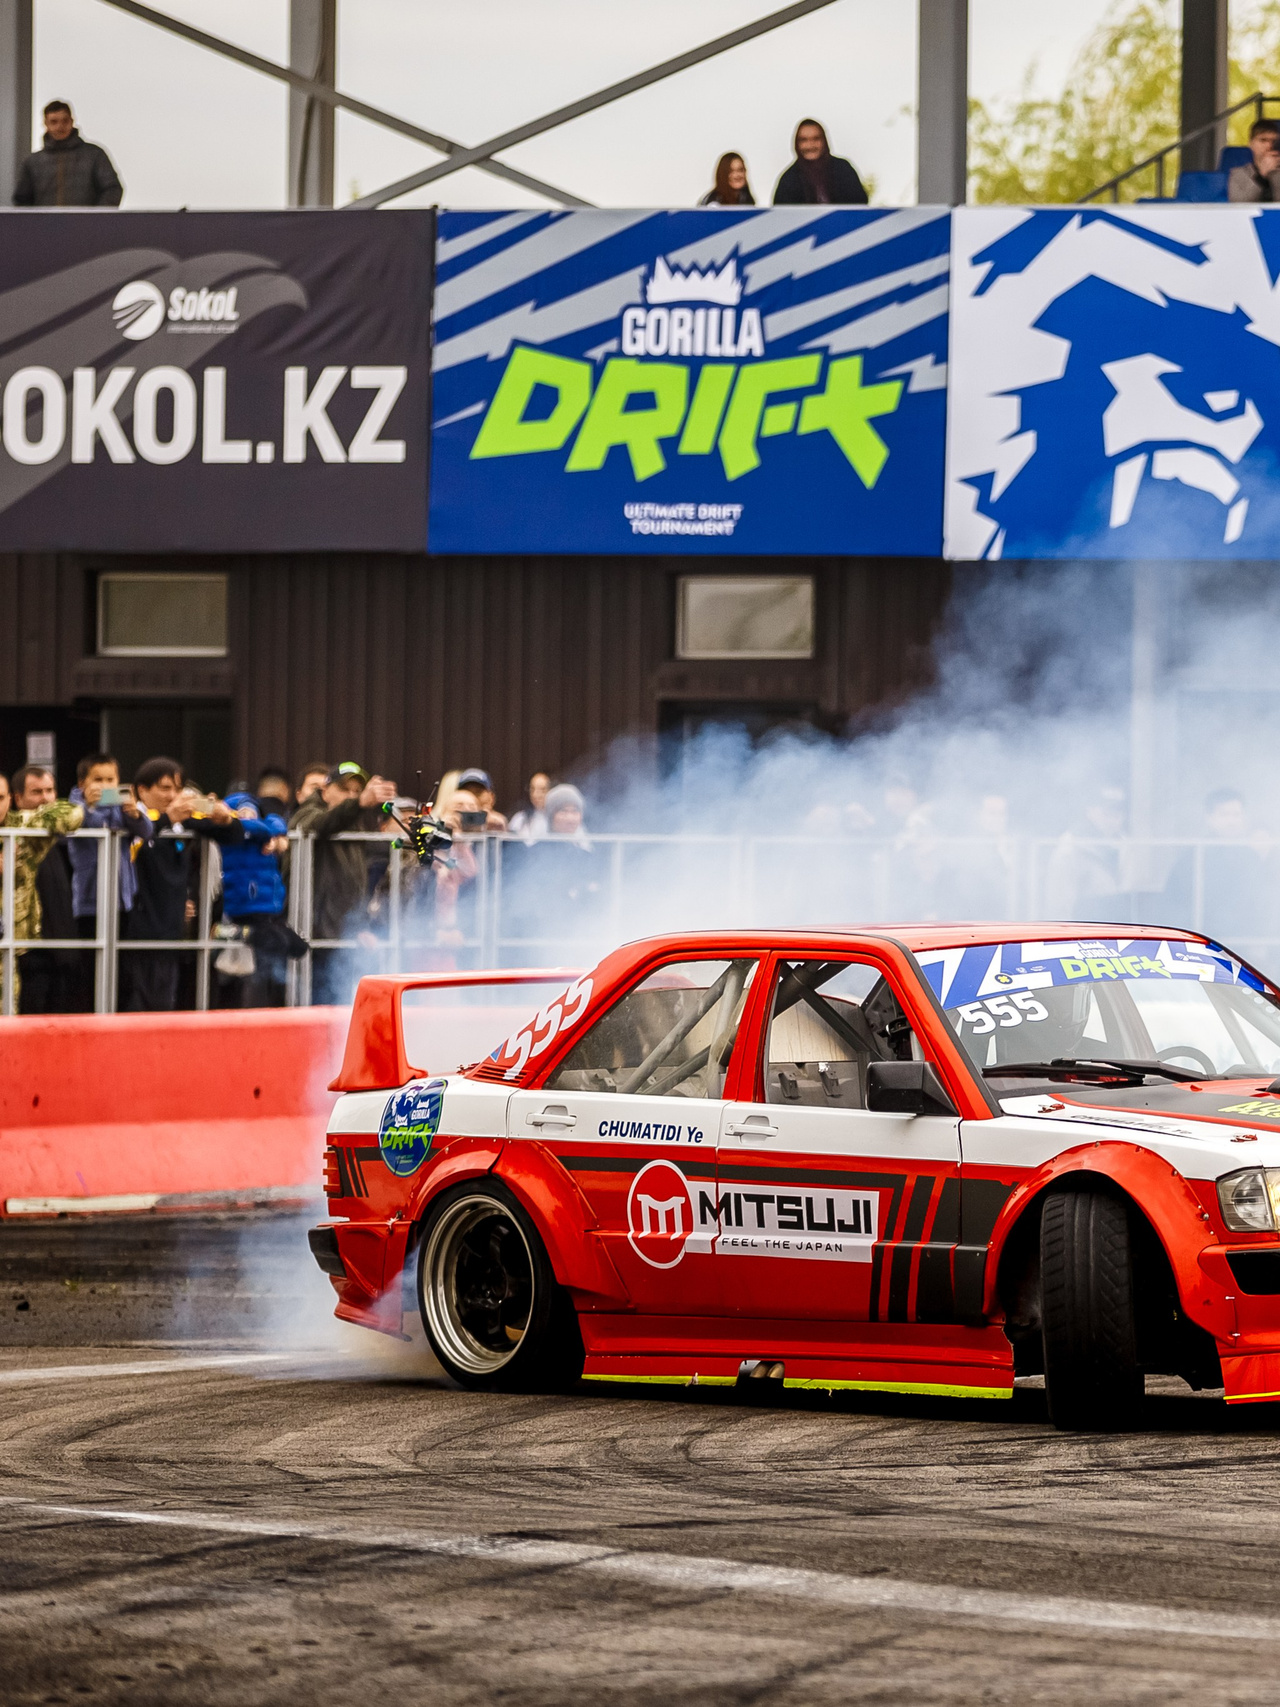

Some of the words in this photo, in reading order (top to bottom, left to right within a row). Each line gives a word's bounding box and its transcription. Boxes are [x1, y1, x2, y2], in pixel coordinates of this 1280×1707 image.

[622, 308, 764, 356] GORILLA
[0, 365, 407, 465] OKOL.KZ
[469, 347, 903, 490] DRIFT
[624, 502, 696, 519] ULTIMATE
[698, 503, 743, 520] DRIFT
[630, 519, 736, 536] TOURNAMENT
[1080, 948, 1122, 958] GORILLA
[1060, 956, 1171, 979] DRIFT
[956, 990, 1049, 1034] 555
[502, 976, 594, 1080] 555
[382, 1123, 433, 1150] DRIFT
[598, 1120, 683, 1142] CHUMATIDI
[687, 1126, 704, 1143] Ye
[699, 1191, 873, 1235] MITSUJI
[721, 1237, 758, 1248] FEEL
[764, 1239, 791, 1250] THE
[796, 1241, 843, 1253] JAPAN
